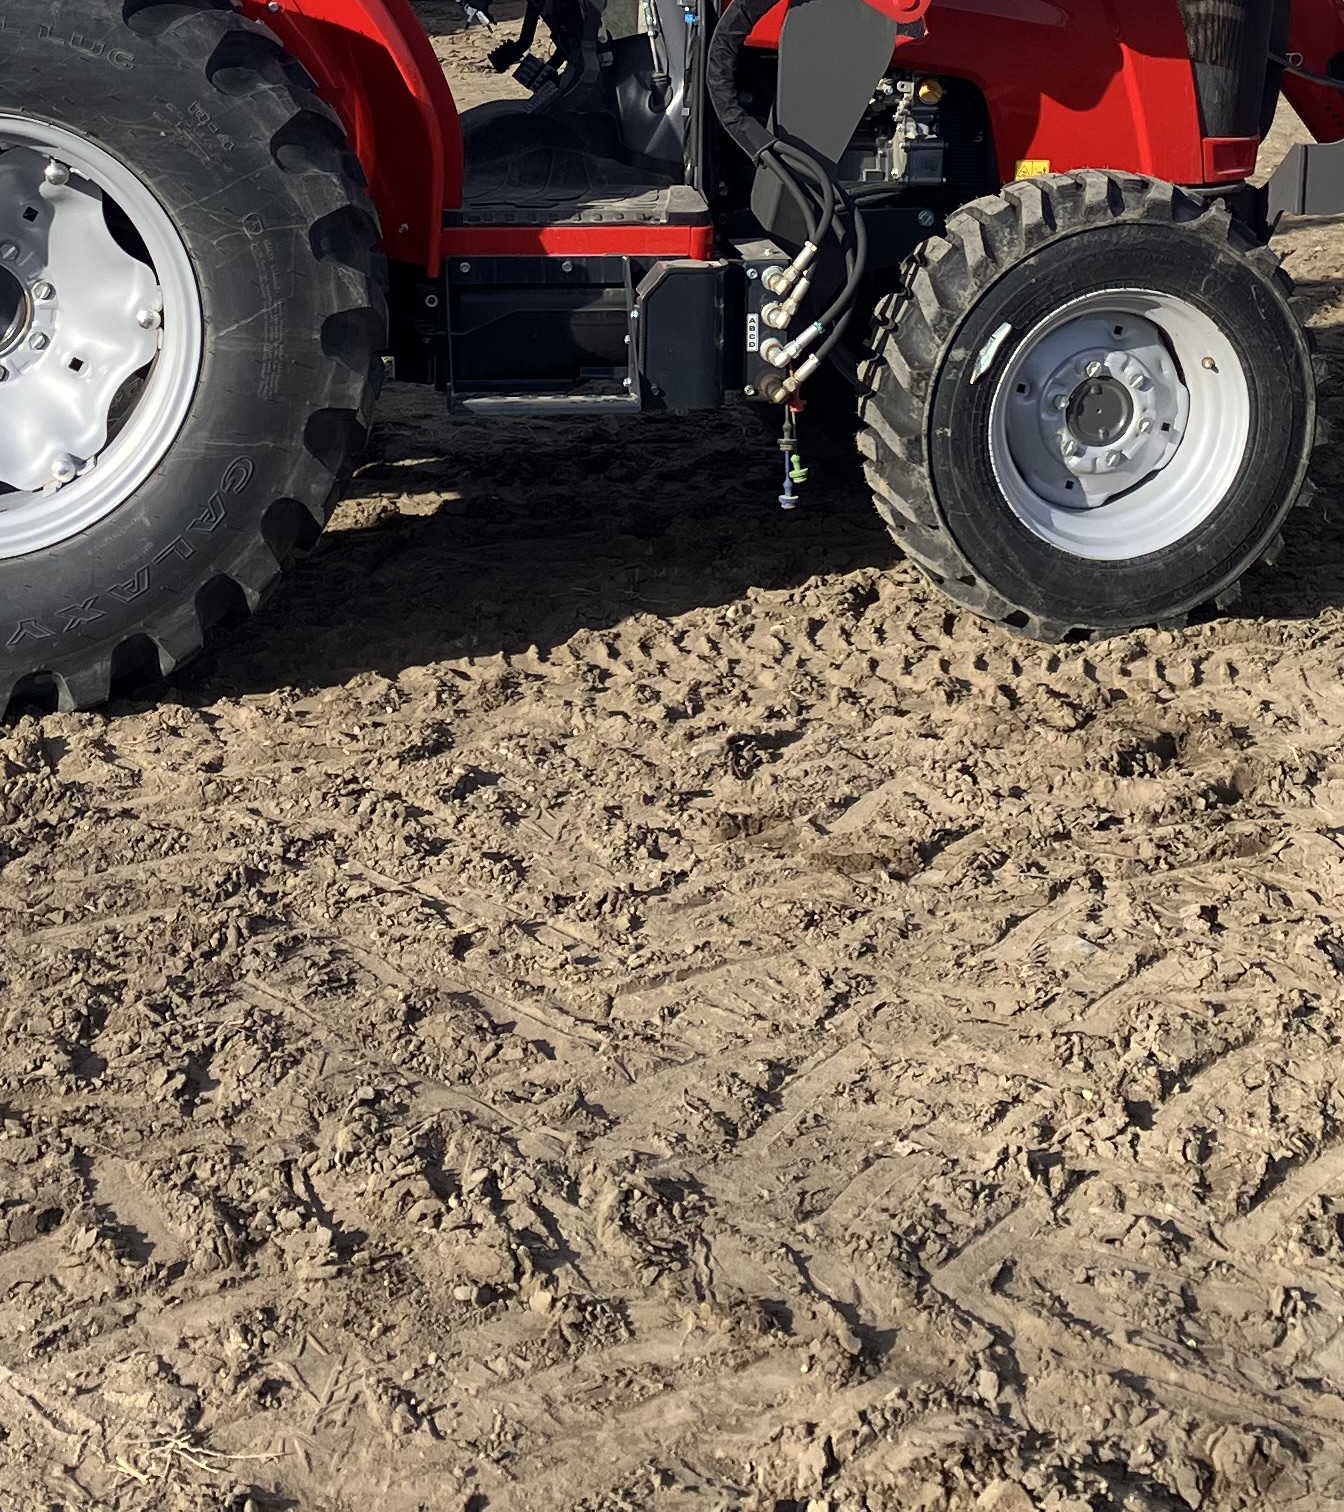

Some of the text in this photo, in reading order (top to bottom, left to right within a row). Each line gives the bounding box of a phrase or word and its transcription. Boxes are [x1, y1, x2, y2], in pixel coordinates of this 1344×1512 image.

[37, 24, 140, 74] LUG
[187, 100, 237, 152] R-4
[4, 455, 256, 650] GALAXY
